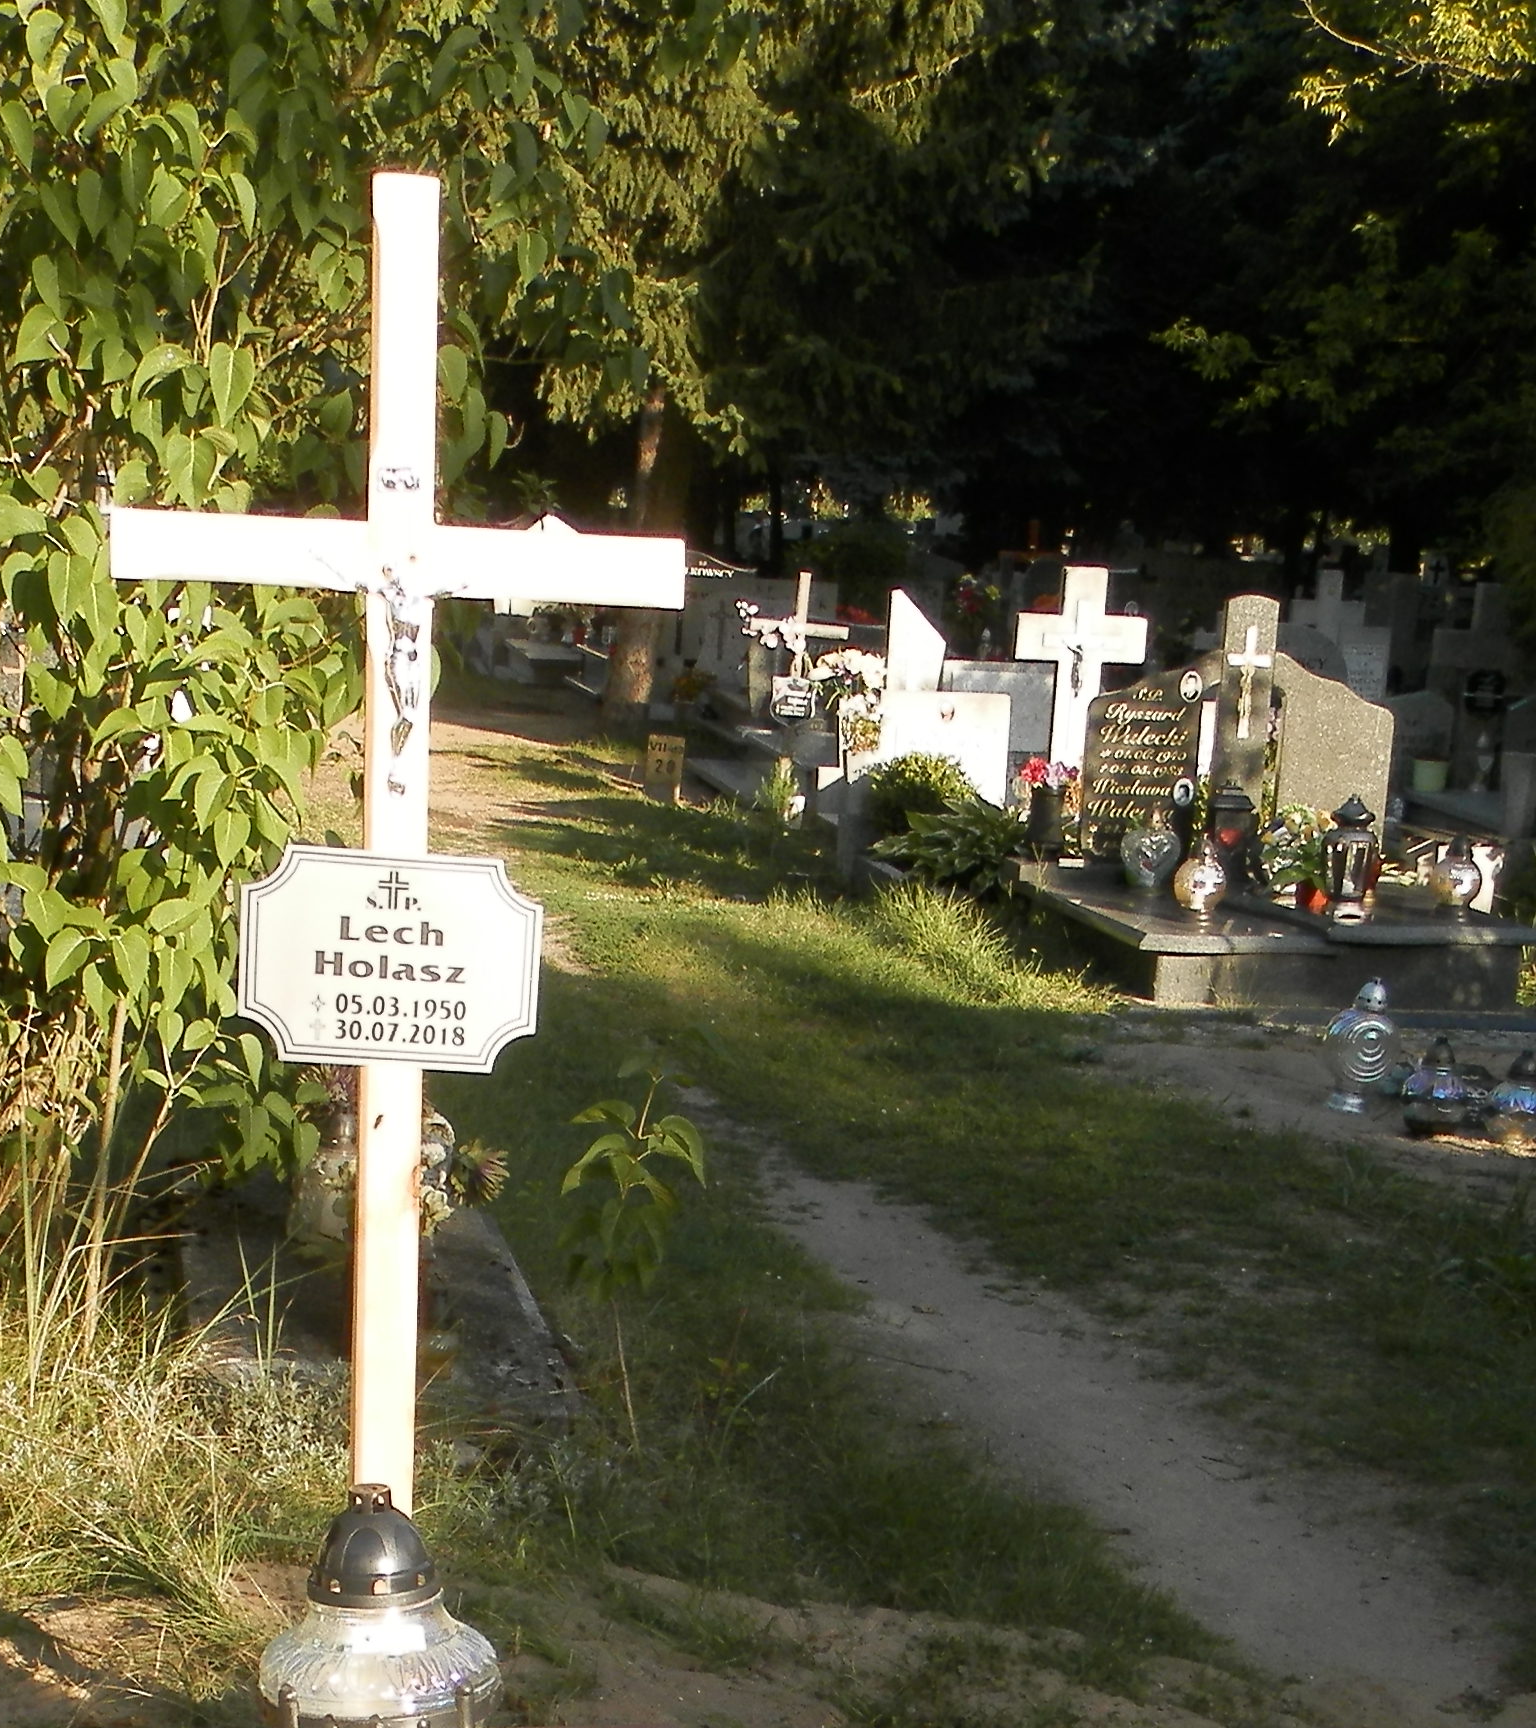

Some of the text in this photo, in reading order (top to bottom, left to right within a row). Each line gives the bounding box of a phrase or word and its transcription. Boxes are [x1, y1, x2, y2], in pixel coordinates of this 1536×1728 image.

[1105, 702, 1187, 726] Ryszard
[339, 915, 444, 947] Lech
[315, 950, 466, 984] Holasz
[335, 993, 467, 1021] 05.03.1950
[335, 1019, 466, 1047] 30.07.2018
